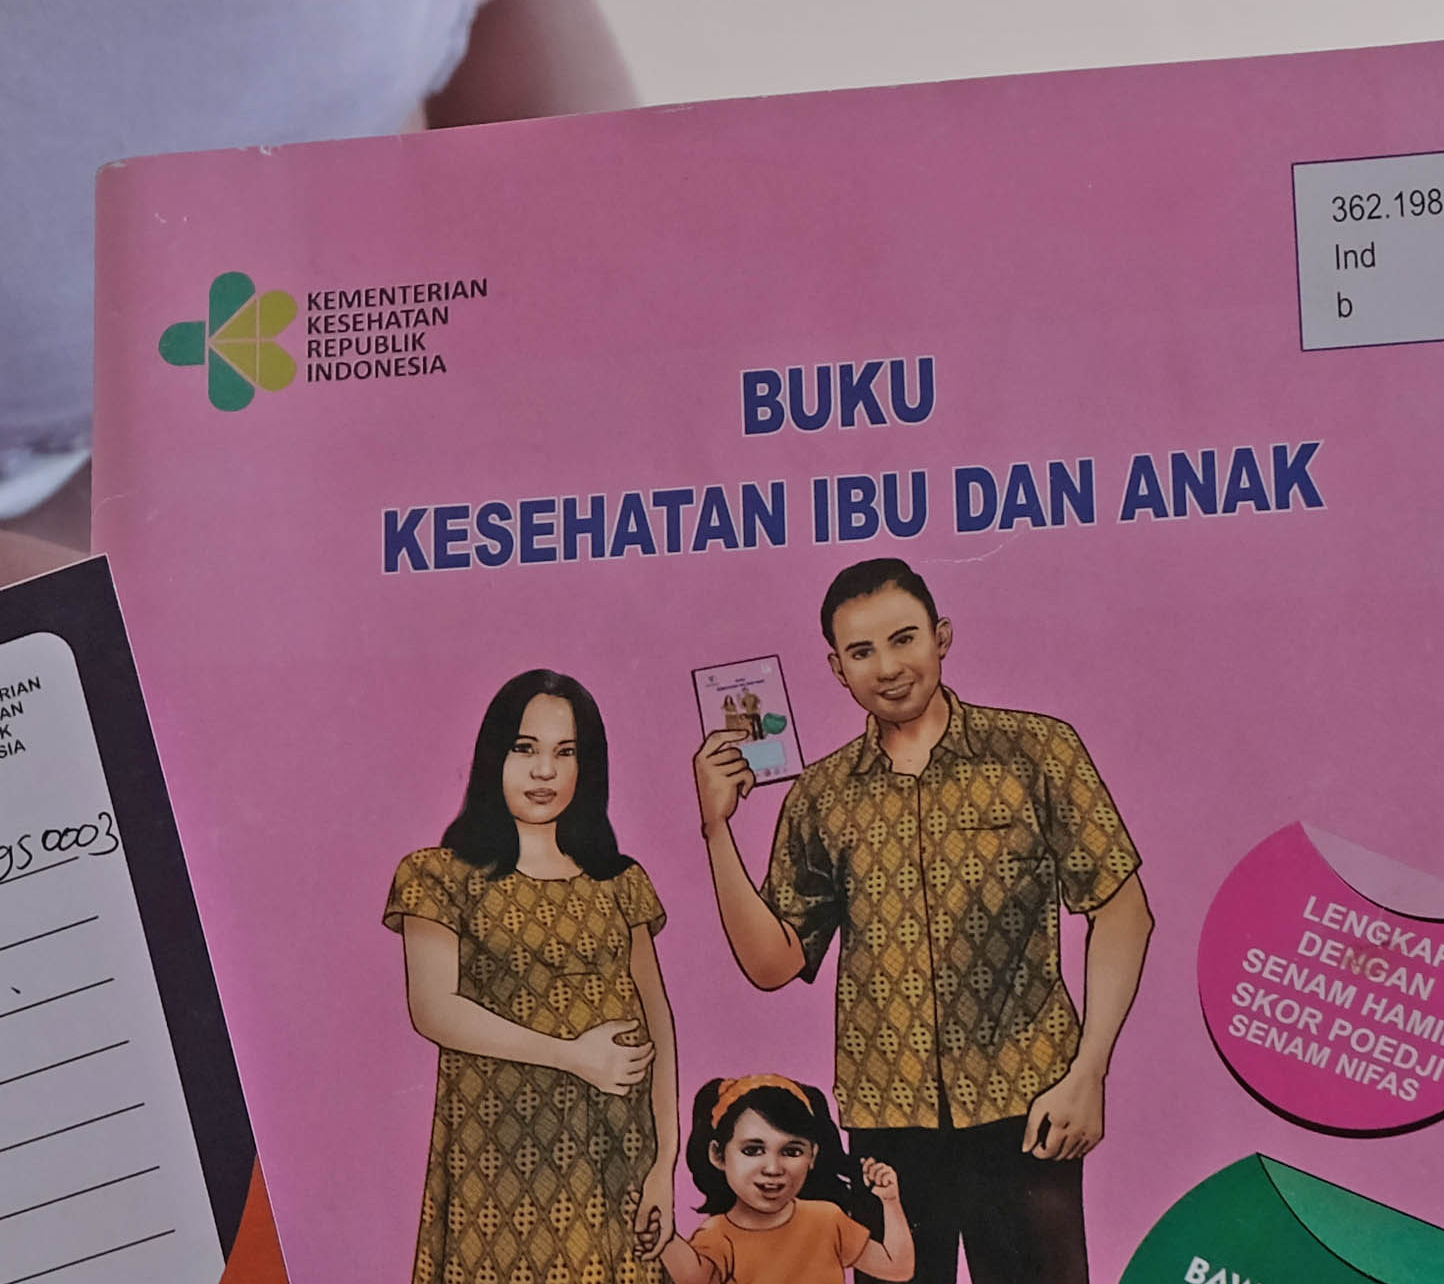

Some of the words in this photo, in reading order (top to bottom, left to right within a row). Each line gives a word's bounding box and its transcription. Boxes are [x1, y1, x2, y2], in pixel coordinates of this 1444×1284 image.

[1336, 241, 1376, 270] Ind
[307, 278, 488, 311] KEMENTERIAN
[1337, 292, 1353, 318] b
[307, 306, 450, 335] KESEHATAN
[307, 332, 426, 359] REPUBLIK
[307, 354, 447, 383] INDONESIA
[741, 356, 938, 437] BUKU
[381, 479, 788, 573] KESEHATAN
[811, 468, 930, 544] IBU
[954, 458, 1096, 533] DAN
[1118, 440, 1325, 522] ANAK
[1242, 948, 1357, 1009] SENAM
[1297, 932, 1435, 1000] DENGAN
[1231, 982, 1323, 1035] SKOR
[1229, 1014, 1331, 1068] SENAM
[1335, 1053, 1419, 1101] NIFAS
